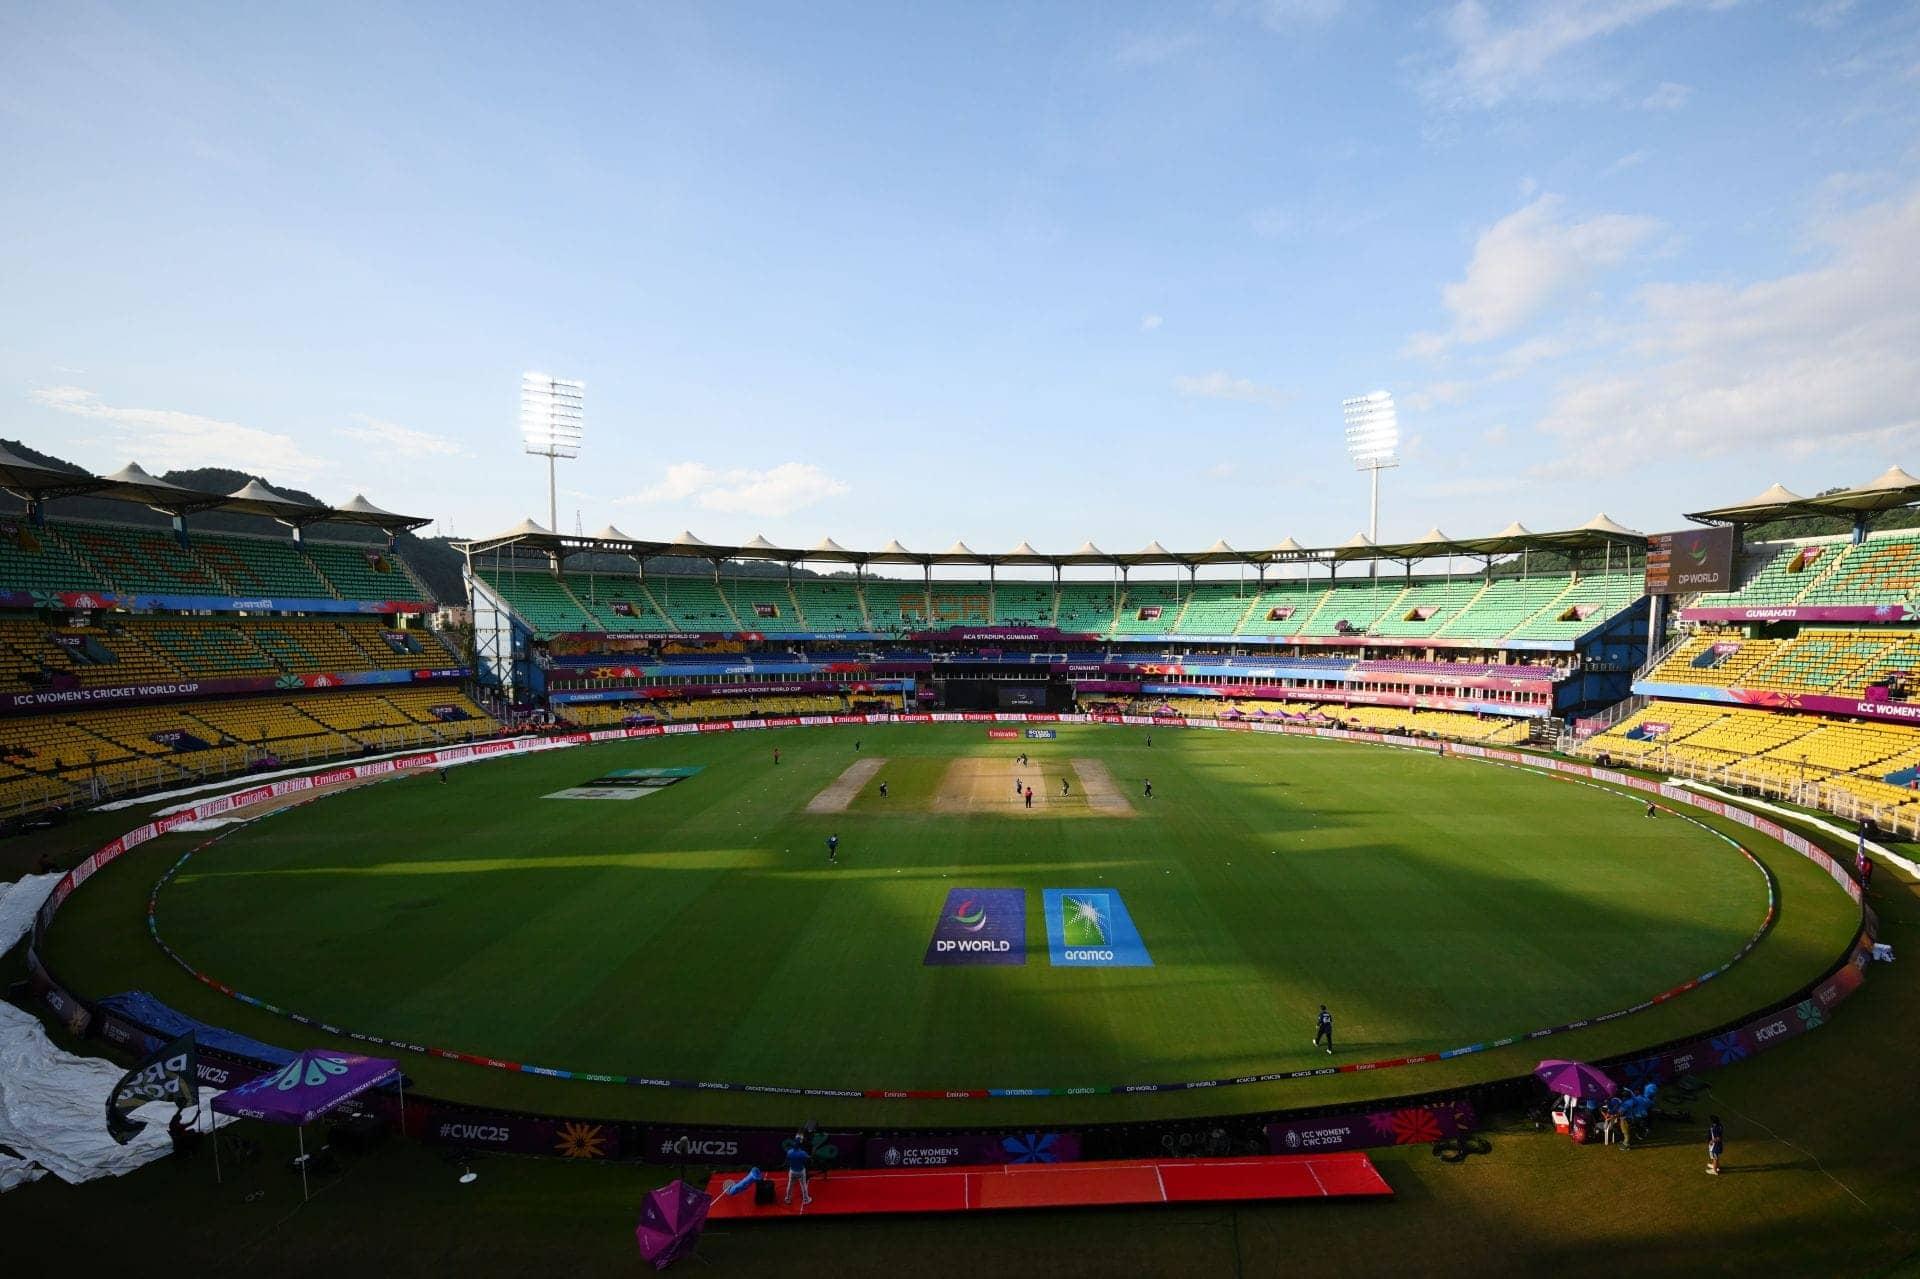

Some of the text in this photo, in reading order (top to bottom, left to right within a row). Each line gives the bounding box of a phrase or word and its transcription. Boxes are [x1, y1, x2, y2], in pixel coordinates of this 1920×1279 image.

[1678, 574, 1690, 585] DP
[1690, 573, 1719, 584] WORLD
[1745, 609, 1797, 618] GUWAHATI
[13, 683, 199, 706] ICC WOMEN'S CRICKET WORLD CUP
[1857, 702, 1874, 713] ICC
[699, 723, 730, 731] Emirates
[768, 718, 797, 726] Emirates
[628, 726, 661, 736] Emirates
[475, 743, 510, 754] Emirates
[396, 755, 432, 769] Emirates
[314, 769, 351, 785] Emirates
[235, 788, 269, 806] Emirates
[1693, 795, 1723, 814] Emirates
[1756, 818, 1782, 839] Emirates
[96, 842, 122, 868] Emirates
[936, 940, 1010, 952] DP WORLD
[1065, 950, 1114, 961] aramco
[1755, 1020, 1788, 1042] #CWC25
[196, 1063, 229, 1084] WC25
[1067, 1087, 1095, 1095] aramco
[439, 1123, 510, 1143] #CWC25
[1301, 1127, 1352, 1139] ICC WOMEN'S
[660, 1139, 738, 1156] #CWC25
[1302, 1136, 1343, 1147] CWC 2025
[903, 1147, 959, 1157] ICC WOMEN'S
[902, 1156, 948, 1166] CWC 2025
